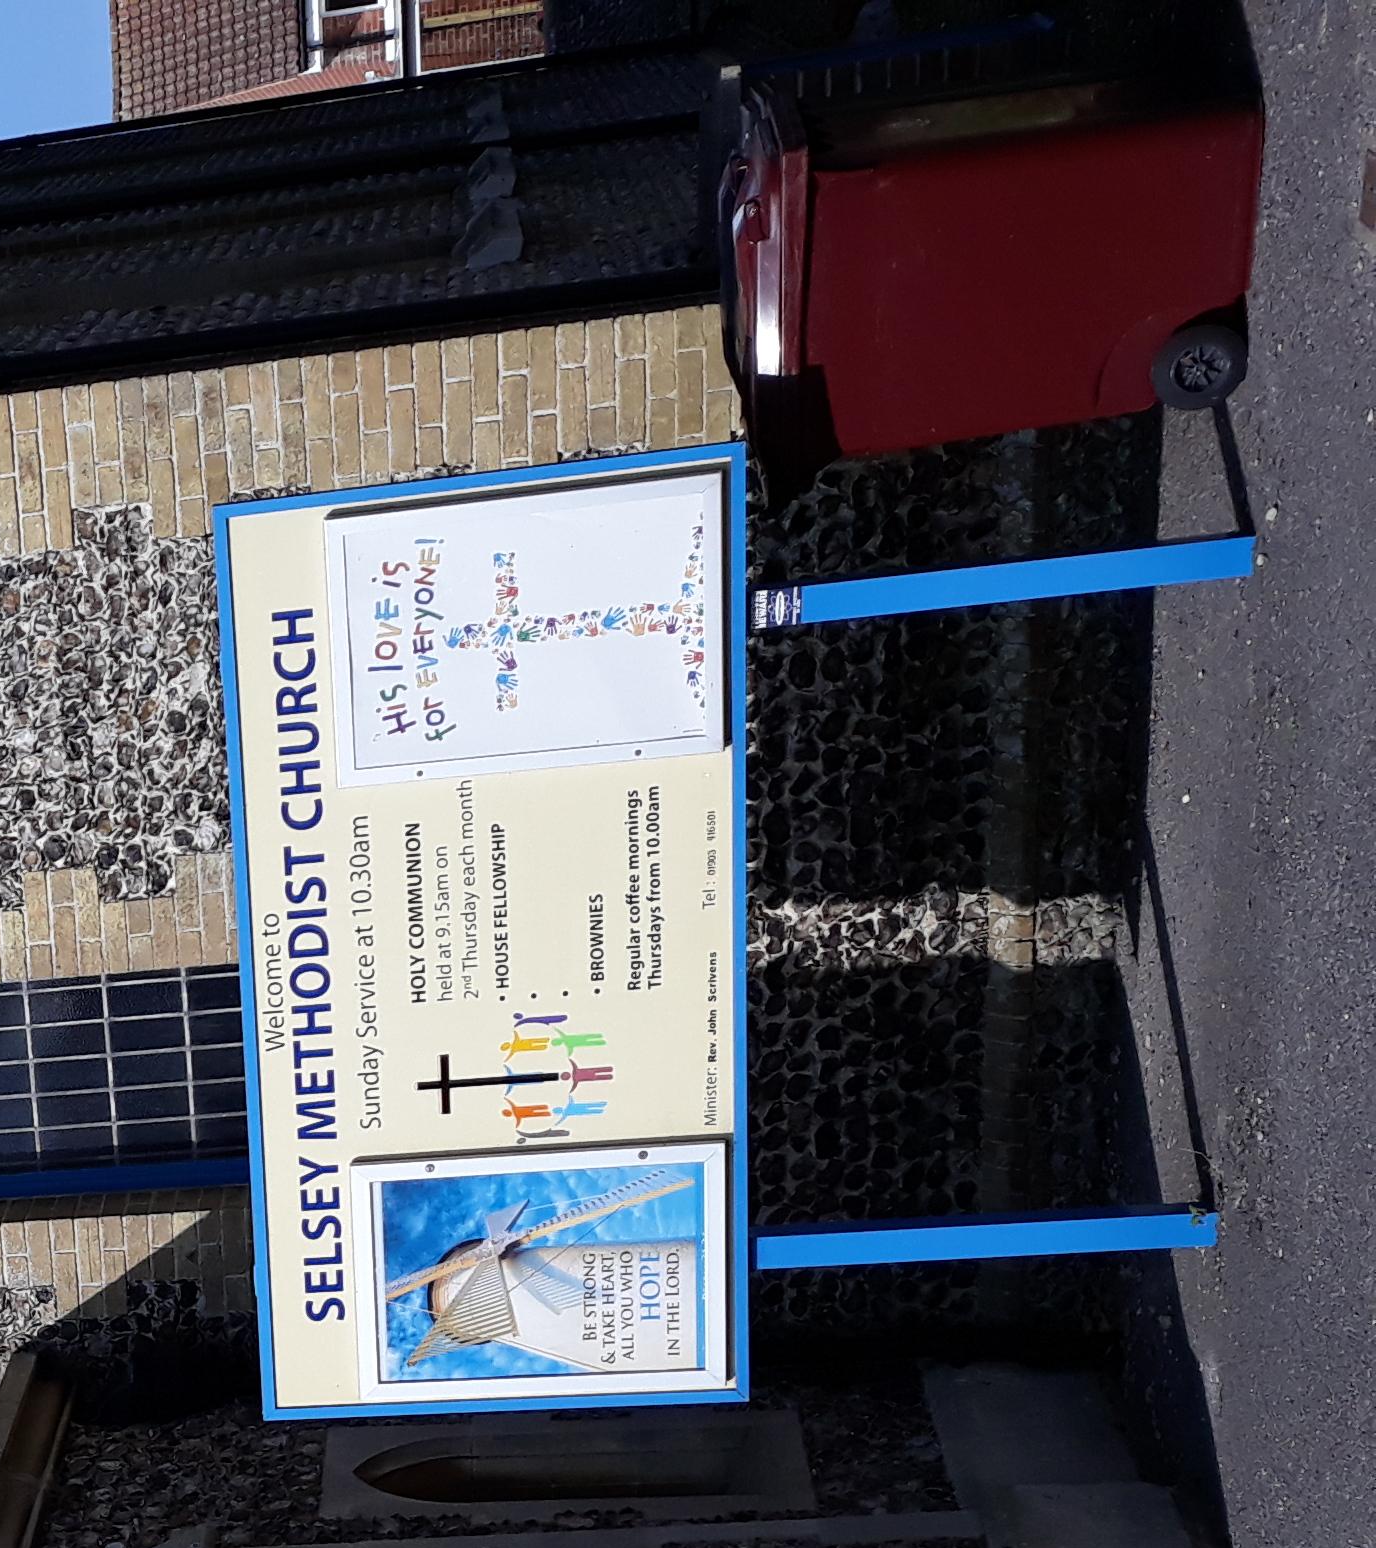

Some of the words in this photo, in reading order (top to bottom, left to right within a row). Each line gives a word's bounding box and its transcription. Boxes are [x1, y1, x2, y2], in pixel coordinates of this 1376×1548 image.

[372, 561, 410, 588] is
[271, 608, 324, 831] CHURCH
[376, 684, 416, 735] His
[423, 697, 457, 741] for
[456, 779, 474, 839] month
[624, 790, 642, 869] mornings
[646, 786, 660, 857] 10.00am
[350, 815, 373, 916] 10.30am
[435, 845, 448, 869] on
[458, 845, 475, 886] each
[491, 823, 508, 928] FELLOWSHIP
[647, 863, 661, 902] from
[707, 849, 717, 876] 01903
[405, 822, 424, 949] COMMUNION
[435, 874, 451, 938] 9.15am
[625, 874, 640, 923] coffee
[261, 913, 282, 937] to
[354, 925, 374, 948] at
[460, 892, 480, 972] Thursday
[589, 894, 604, 982] BROWNIES
[647, 906, 664, 989] Thursdays
[438, 943, 452, 959] at
[494, 932, 509, 989] HOUSE
[626, 928, 645, 990] Regular
[262, 944, 286, 1051] Welcome
[284, 845, 337, 1140] METHODIST
[354, 954, 378, 1038] Service
[410, 955, 427, 1003] HOLY
[436, 964, 453, 1001] held
[461, 975, 479, 999] 2nd
[707, 951, 717, 1003] Scrivens
[707, 1009, 717, 1035] John
[707, 1039, 717, 1063] Rev.
[358, 1044, 384, 1129] Sunday
[703, 1067, 717, 1126] Minister:
[298, 1156, 345, 1322] SELSEY
[582, 1252, 597, 1318] STRONG
[601, 1251, 617, 1305] HEART,
[619, 1251, 633, 1292] WHO
[639, 1251, 661, 1321] HOPE
[601, 1310, 615, 1348] TAKE
[620, 1297, 634, 1330] YOU
[667, 1301, 680, 1328] THE
[601, 1351, 616, 1364] &
[620, 1334, 634, 1361] ALL
[667, 1332, 680, 1356] IN
